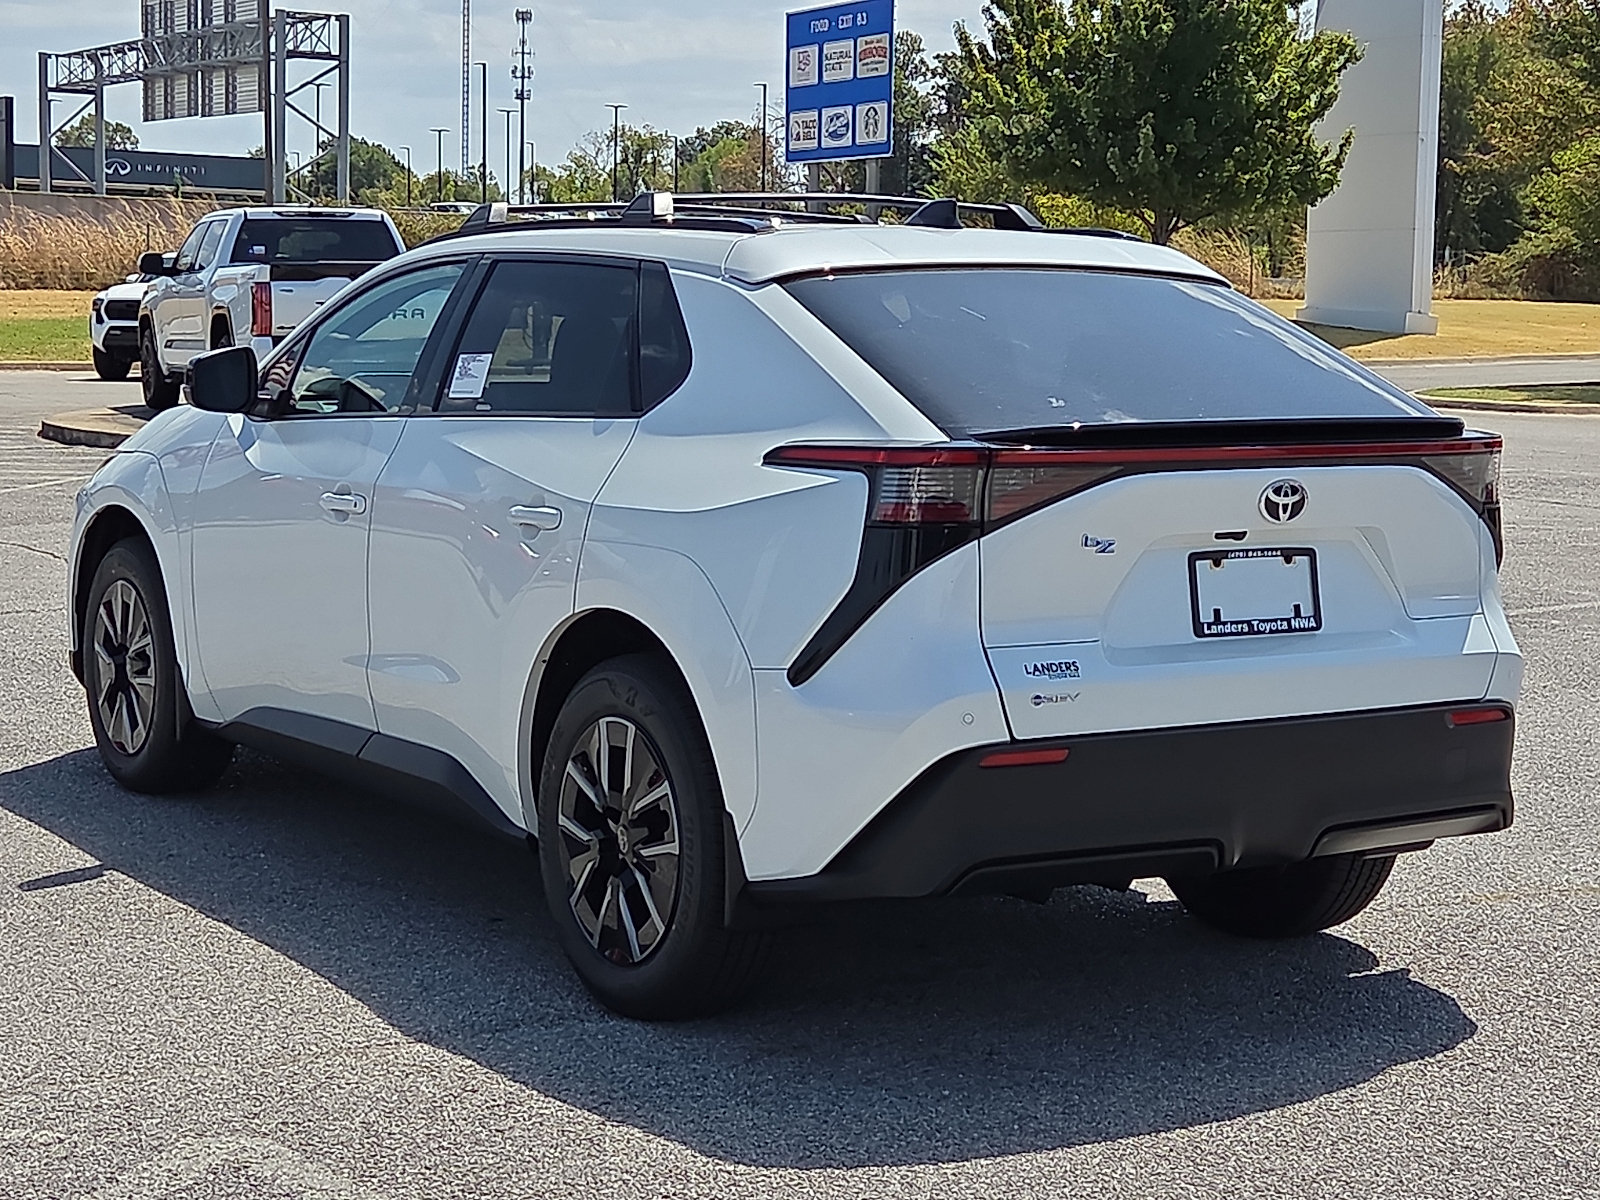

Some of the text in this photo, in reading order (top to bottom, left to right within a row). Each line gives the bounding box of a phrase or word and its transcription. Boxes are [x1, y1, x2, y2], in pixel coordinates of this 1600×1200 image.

[811, 19, 829, 33] FOOD
[838, 14, 853, 29] EXIT
[825, 50, 852, 61] NATURAL
[825, 62, 842, 72] STATE
[802, 119, 816, 130] TACO
[137, 164, 205, 175] INFINITI
[1203, 617, 1317, 635] Landers Toyota NWA
[1023, 660, 1080, 677] LANDERS
